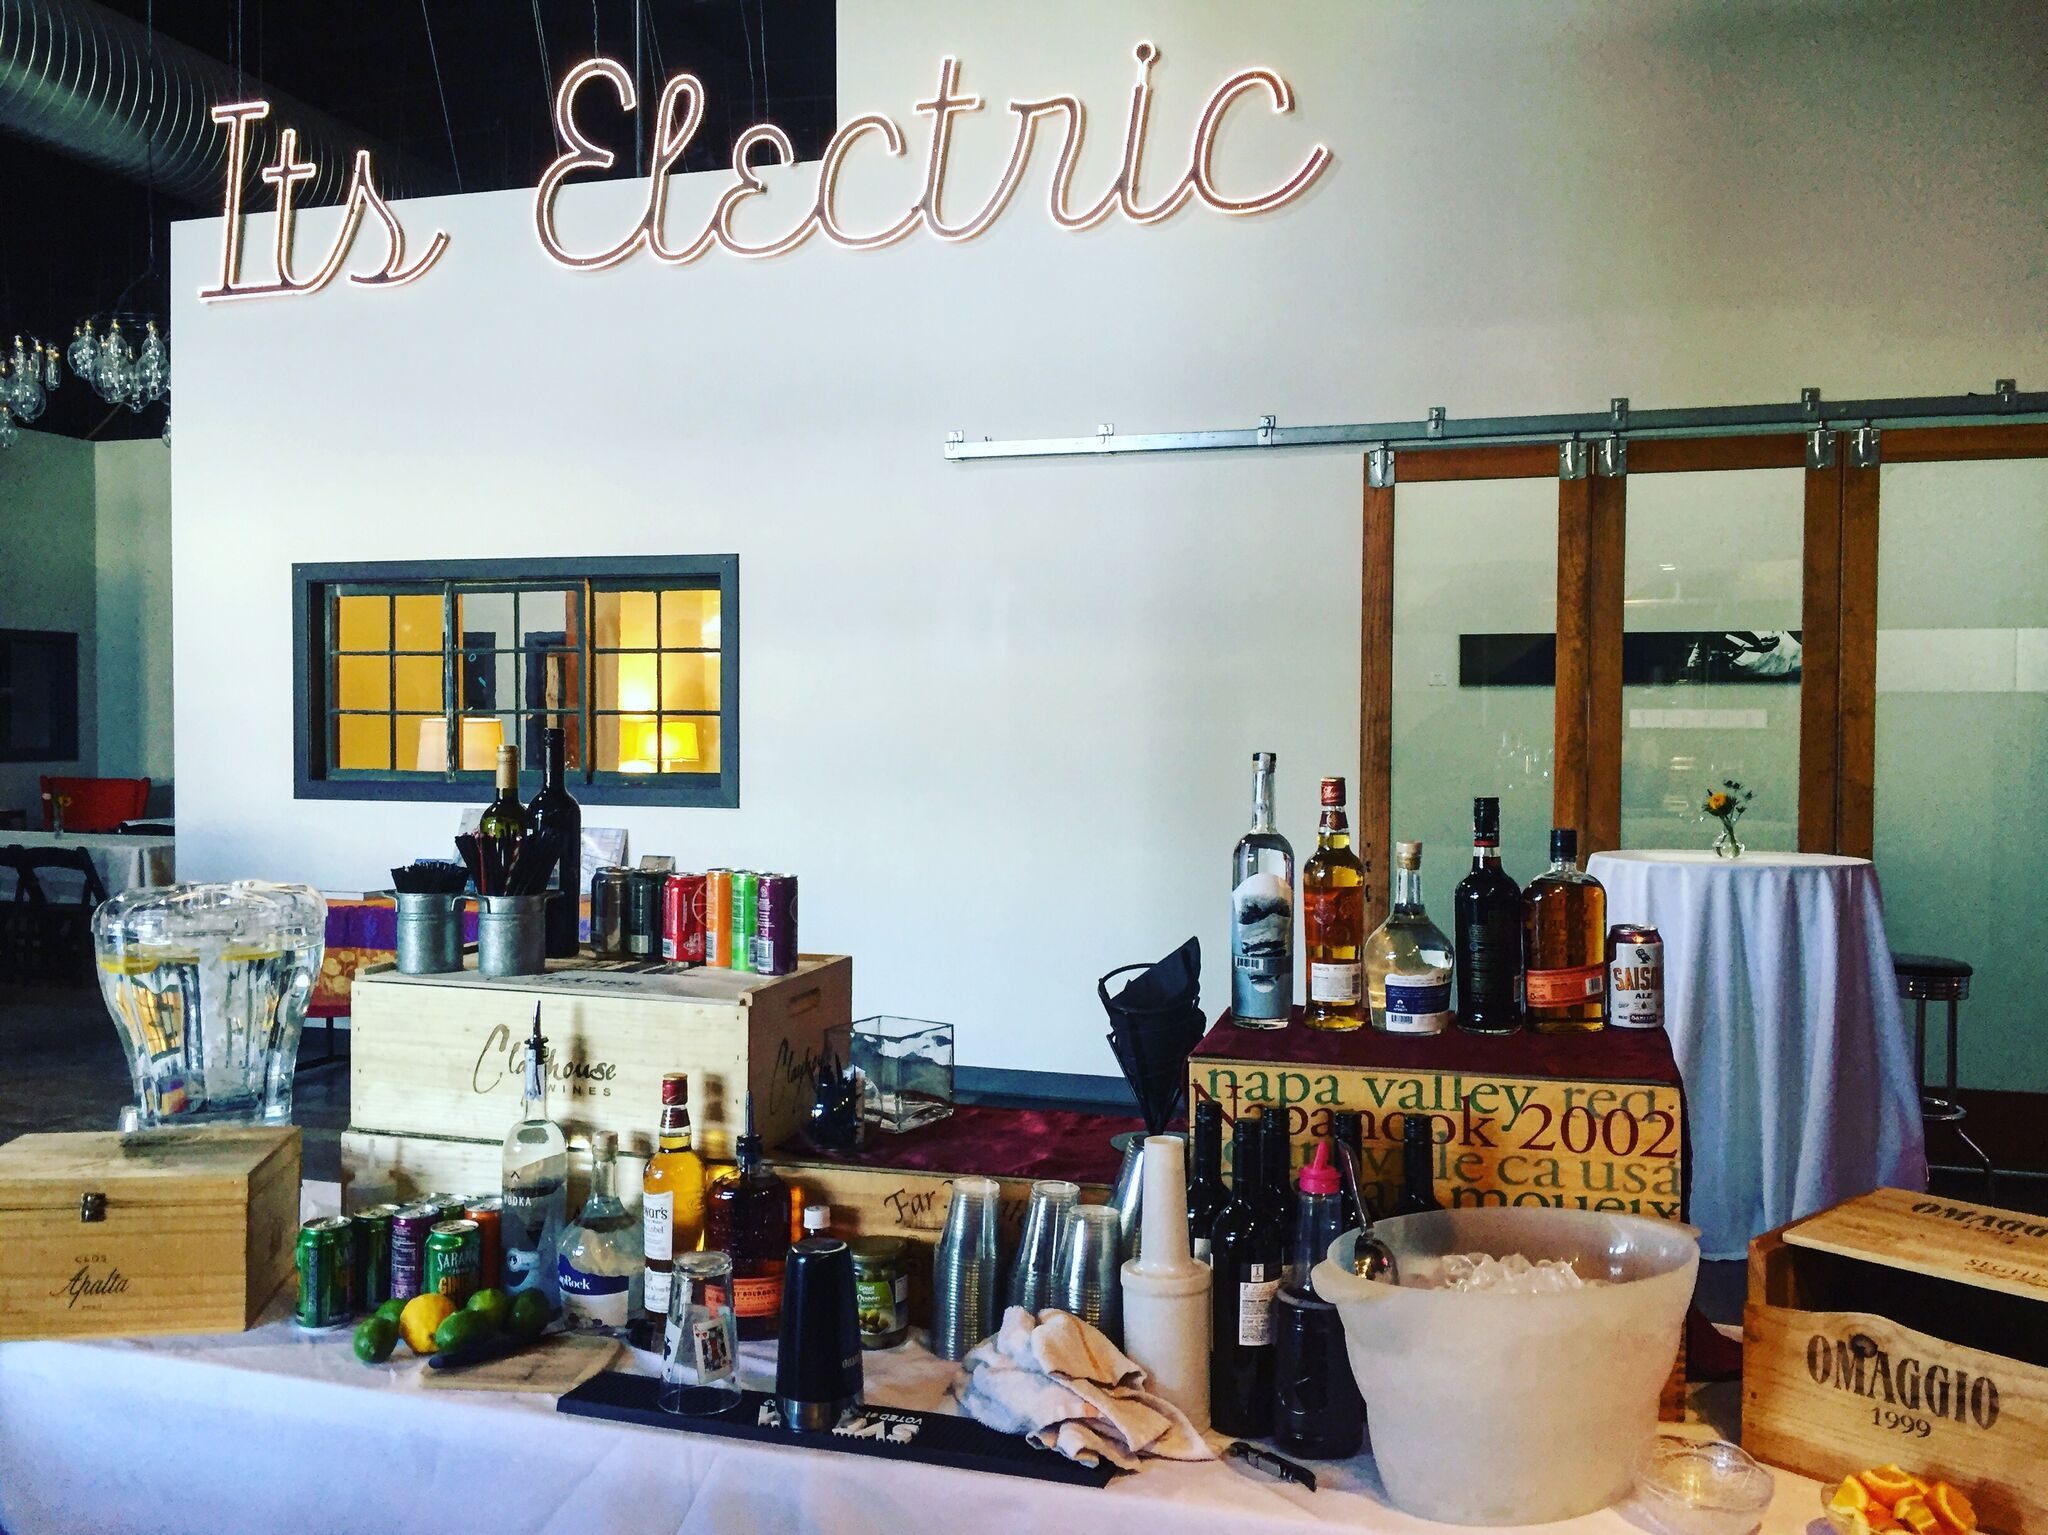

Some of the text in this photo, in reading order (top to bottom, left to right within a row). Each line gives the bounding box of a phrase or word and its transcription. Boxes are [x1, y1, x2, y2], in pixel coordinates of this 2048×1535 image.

[199, 40, 1334, 303] Its Electric
[1208, 1068, 1345, 1109] napa
[1363, 1074, 1538, 1132] valley
[1518, 1103, 1678, 1159] 2002
[1497, 1155, 1566, 1188] ca
[1579, 1160, 1681, 1197] usa
[503, 1195, 532, 1207] VODKA
[884, 1188, 937, 1224] Far
[75, 1255, 107, 1263] CLOS
[49, 1265, 129, 1308] Apalta
[1806, 1334, 2000, 1430] OMAGGIO
[880, 1413, 923, 1425] VOTED
[1871, 1406, 1932, 1439] 1999
